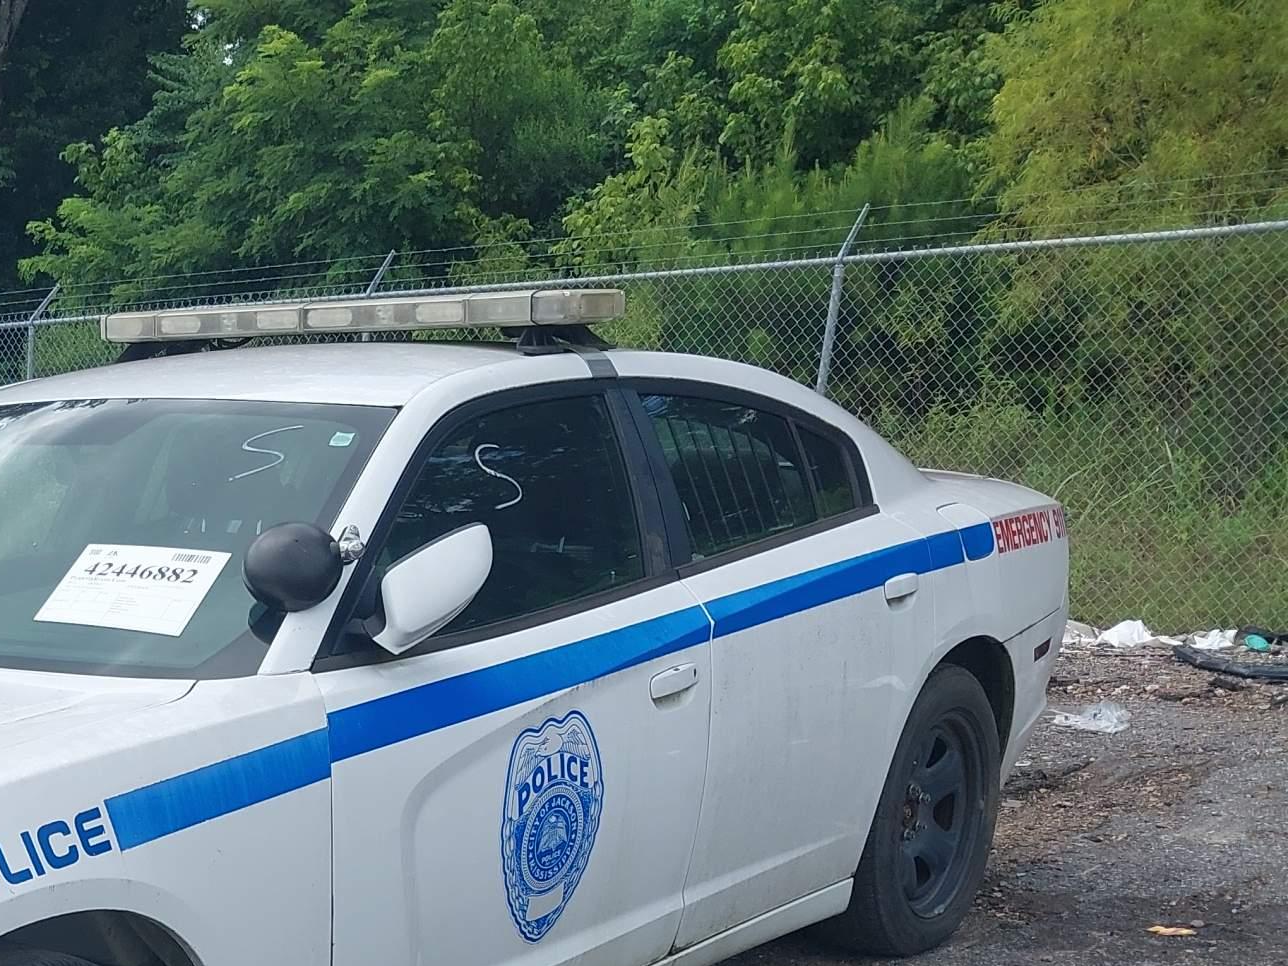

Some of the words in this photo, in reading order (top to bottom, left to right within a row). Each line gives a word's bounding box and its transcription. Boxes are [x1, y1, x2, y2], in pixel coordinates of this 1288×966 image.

[992, 510, 1053, 554] EMERGENCY
[84, 561, 199, 584] 42446882
[518, 753, 589, 817] POLICE
[528, 818, 540, 850] CITY
[539, 801, 551, 818] OF
[551, 797, 578, 831] JACKSON
